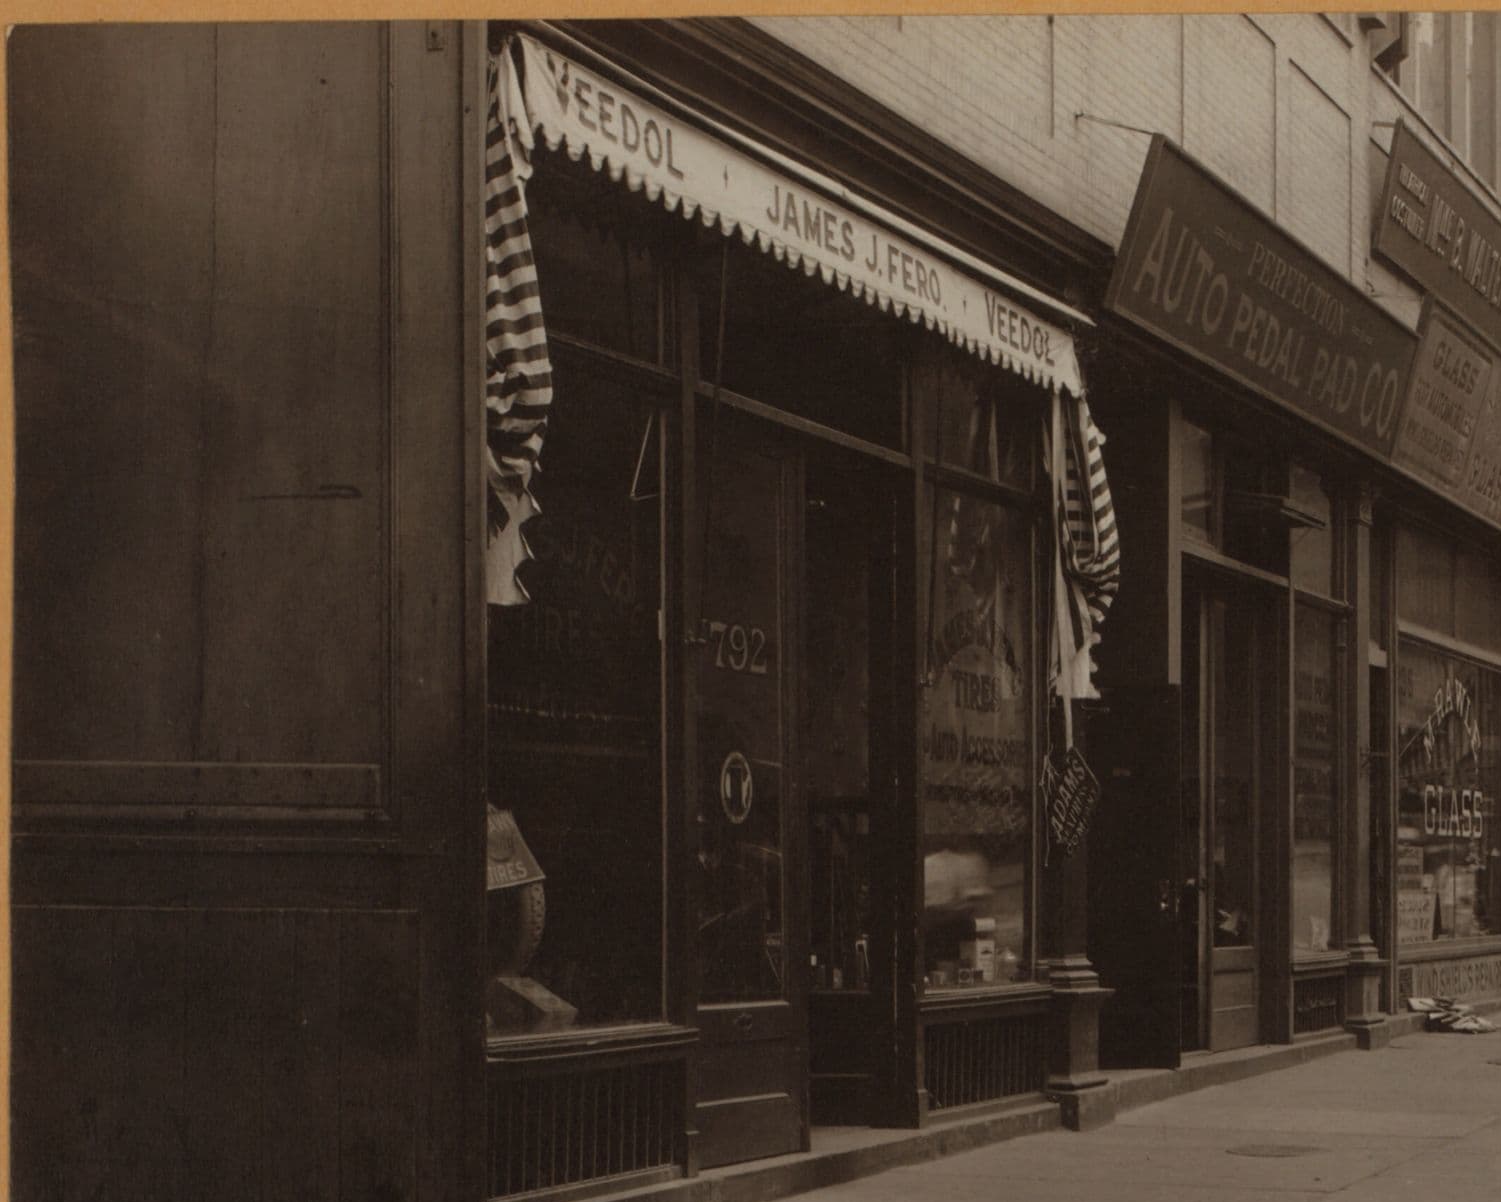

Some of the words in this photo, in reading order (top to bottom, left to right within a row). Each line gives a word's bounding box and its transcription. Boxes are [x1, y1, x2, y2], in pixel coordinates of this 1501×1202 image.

[546, 53, 685, 181] VEEDOL
[766, 185, 855, 262] JAMES
[865, 238, 883, 276] J.
[983, 291, 1056, 367] VEEDOL
[1134, 207, 1230, 336] AUTO
[1231, 307, 1300, 387] PEDAL
[1307, 347, 1359, 414] PAD
[1360, 362, 1399, 441] CO.
[1247, 242, 1345, 337] PERFECTION
[1432, 341, 1480, 395] GLASS
[710, 621, 767, 674] 792
[1051, 760, 1085, 843] ADAMS
[1424, 784, 1483, 839] GLASS
